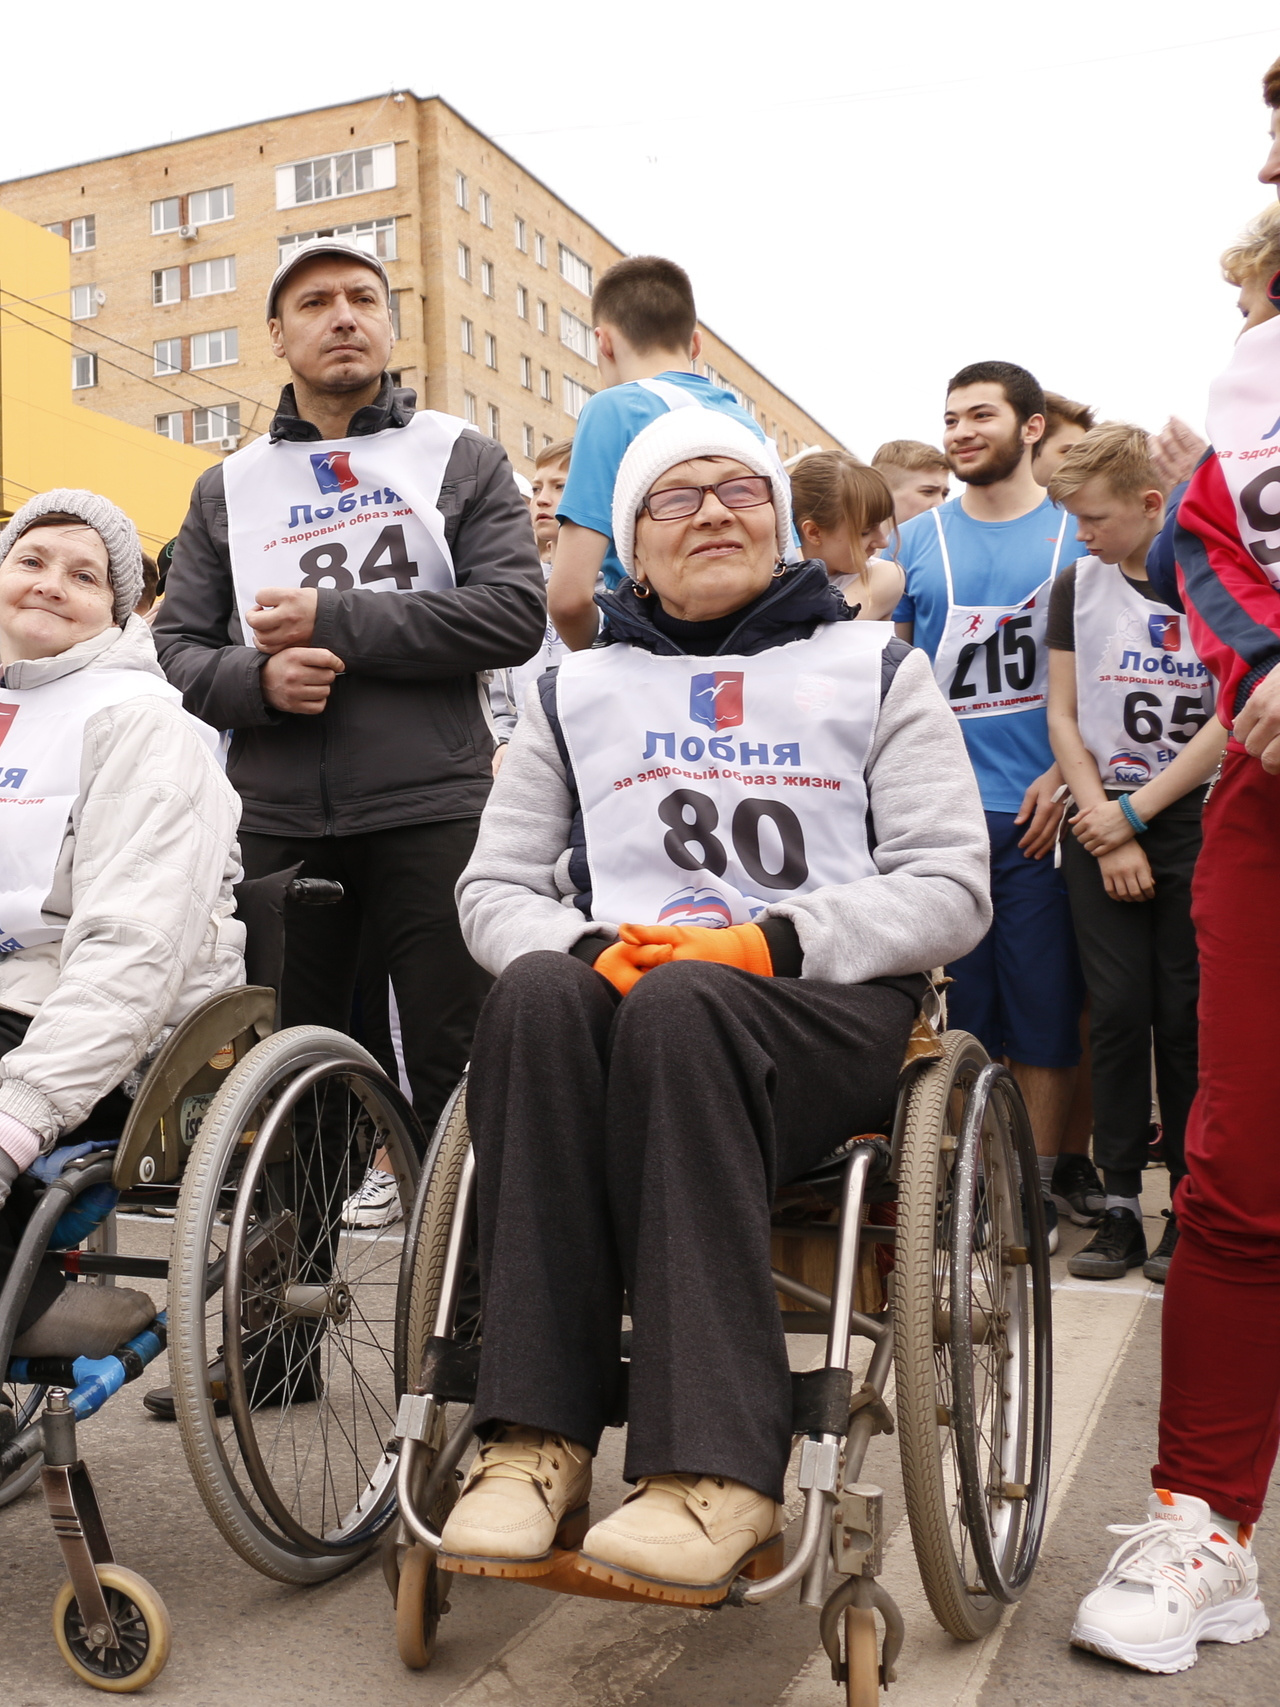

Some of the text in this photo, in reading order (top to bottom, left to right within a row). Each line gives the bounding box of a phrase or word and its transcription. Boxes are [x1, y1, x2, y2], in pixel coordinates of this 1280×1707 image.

[288, 487, 403, 529] Лобня
[263, 540, 277, 552] за
[281, 520, 346, 544] здоровый
[349, 510, 389, 526] образ
[299, 524, 419, 591] 84
[949, 615, 1036, 700] 215
[1119, 650, 1209, 678] Лобня
[1123, 691, 1210, 744] 65
[642, 730, 802, 767] Лобня
[613, 765, 841, 791] за здоровый образ жизни
[657, 788, 809, 890] 80
